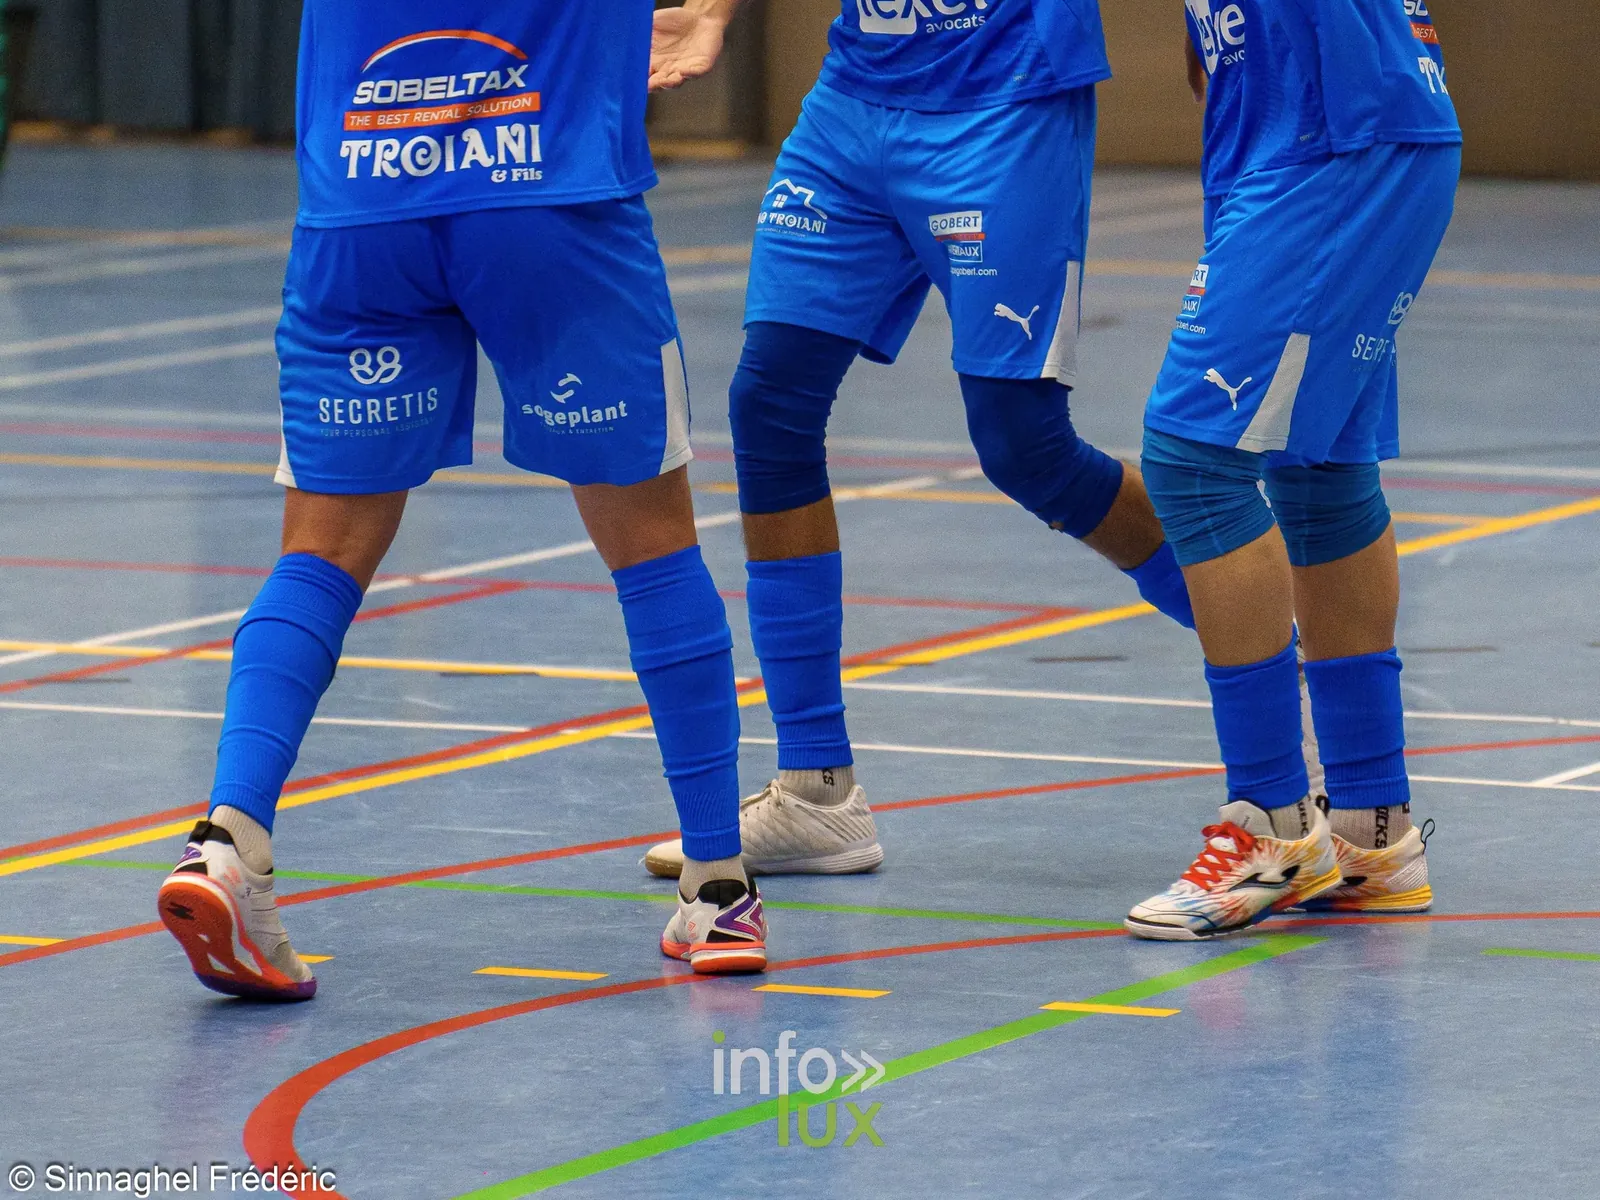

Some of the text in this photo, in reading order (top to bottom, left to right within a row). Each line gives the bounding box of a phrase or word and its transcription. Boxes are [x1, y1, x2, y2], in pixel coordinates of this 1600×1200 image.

[926, 14, 986, 33] avocats
[353, 65, 528, 104] SOBELTAX
[350, 97, 532, 126] THE BEST RENTAL SOLUTION
[340, 123, 542, 178] TROIANI
[491, 168, 543, 183] & Fils
[769, 213, 827, 234] TROIANI
[931, 216, 979, 231] GOBERT
[319, 388, 437, 424] SECRETIS
[522, 400, 628, 427] sogeplant
